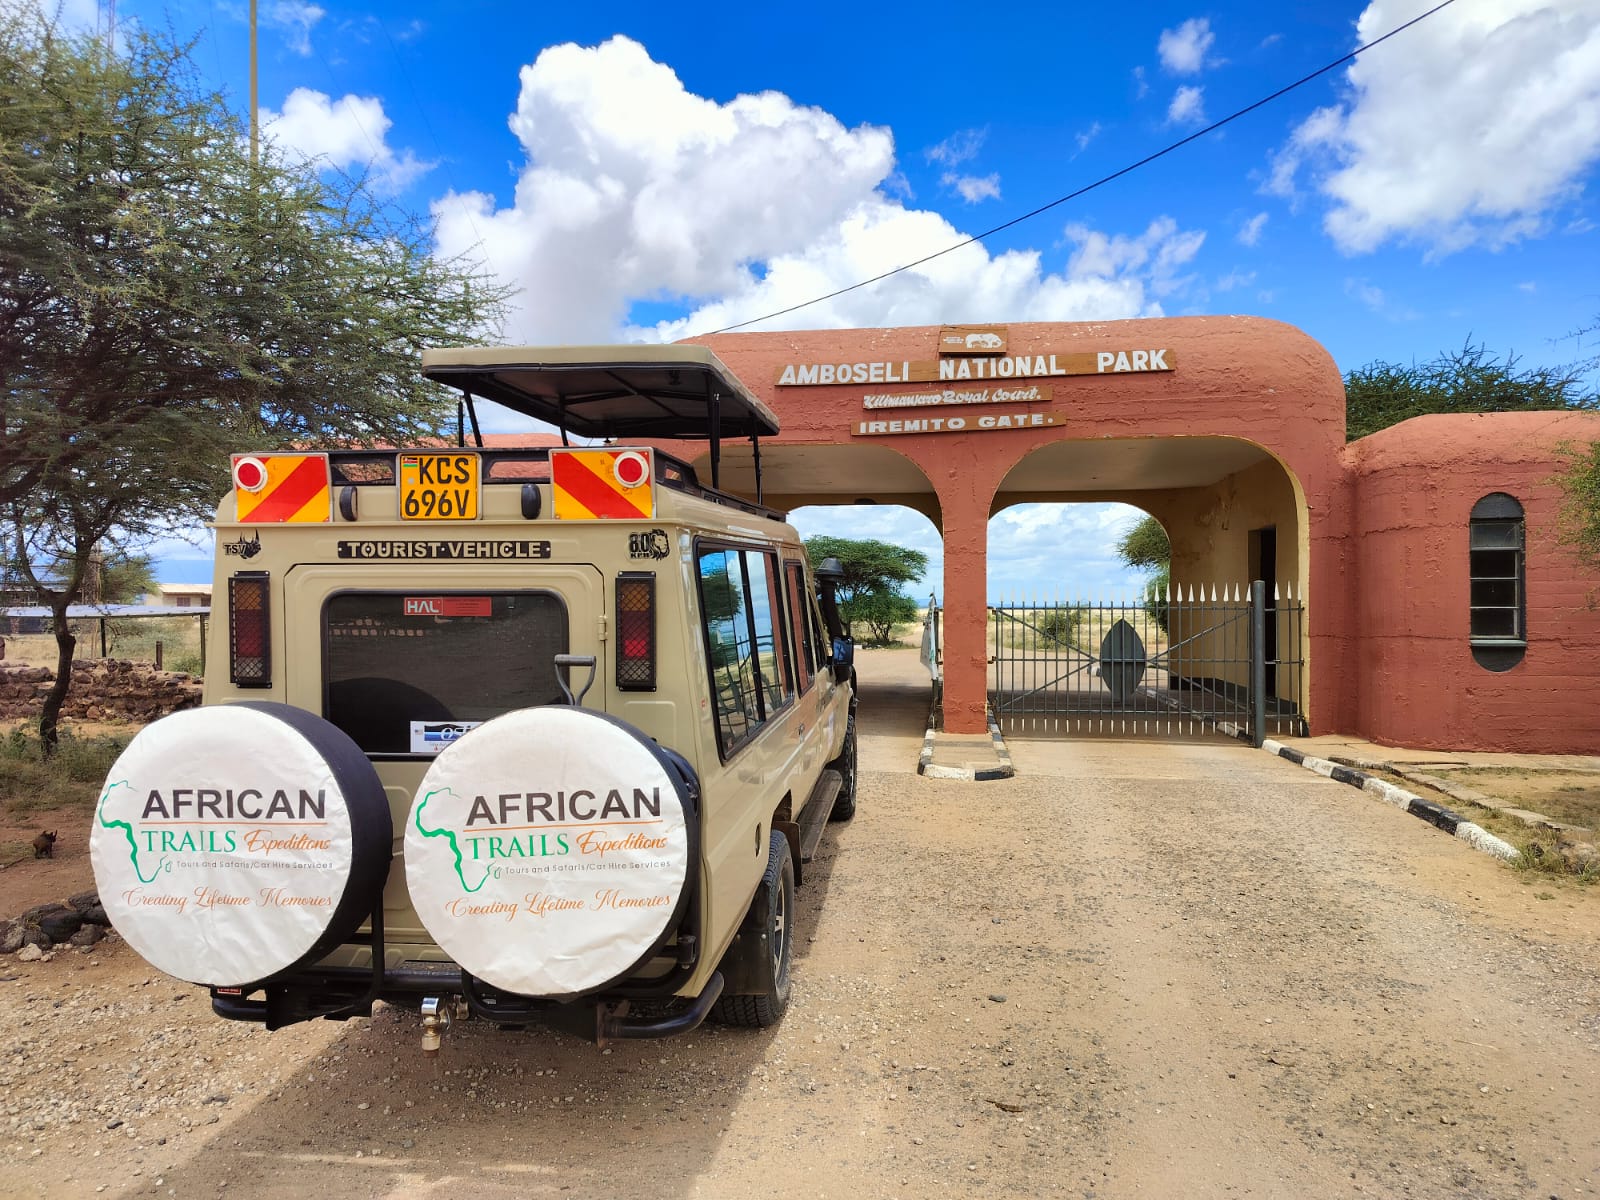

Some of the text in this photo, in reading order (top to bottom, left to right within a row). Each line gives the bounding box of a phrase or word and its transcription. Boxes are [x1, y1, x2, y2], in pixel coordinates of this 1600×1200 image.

[778, 349, 1169, 386] AMBOSELI NATIONAL PARK
[942, 389, 989, 405] Royal
[859, 417, 966, 434] IREMITO
[418, 456, 471, 485] KCS
[404, 489, 470, 518] 696V
[223, 543, 247, 556] TSV
[347, 542, 541, 558] TOURIST VEHICLE
[141, 789, 326, 819] AFRICAN
[465, 786, 661, 827] AFRICAN
[140, 829, 331, 856] TRAILS Expeditions
[465, 830, 668, 860] TRAILS Expeditions
[177, 860, 199, 869] Tours
[201, 861, 217, 869] and
[272, 861, 291, 869] Hire
[293, 862, 333, 870] Services
[505, 866, 530, 875] Tours
[531, 864, 550, 874] and
[608, 862, 628, 871] Hire
[629, 860, 671, 870] Services
[122, 886, 332, 914] Creating Lifetime Memories
[445, 888, 671, 922] Creating Lifetime Memories
